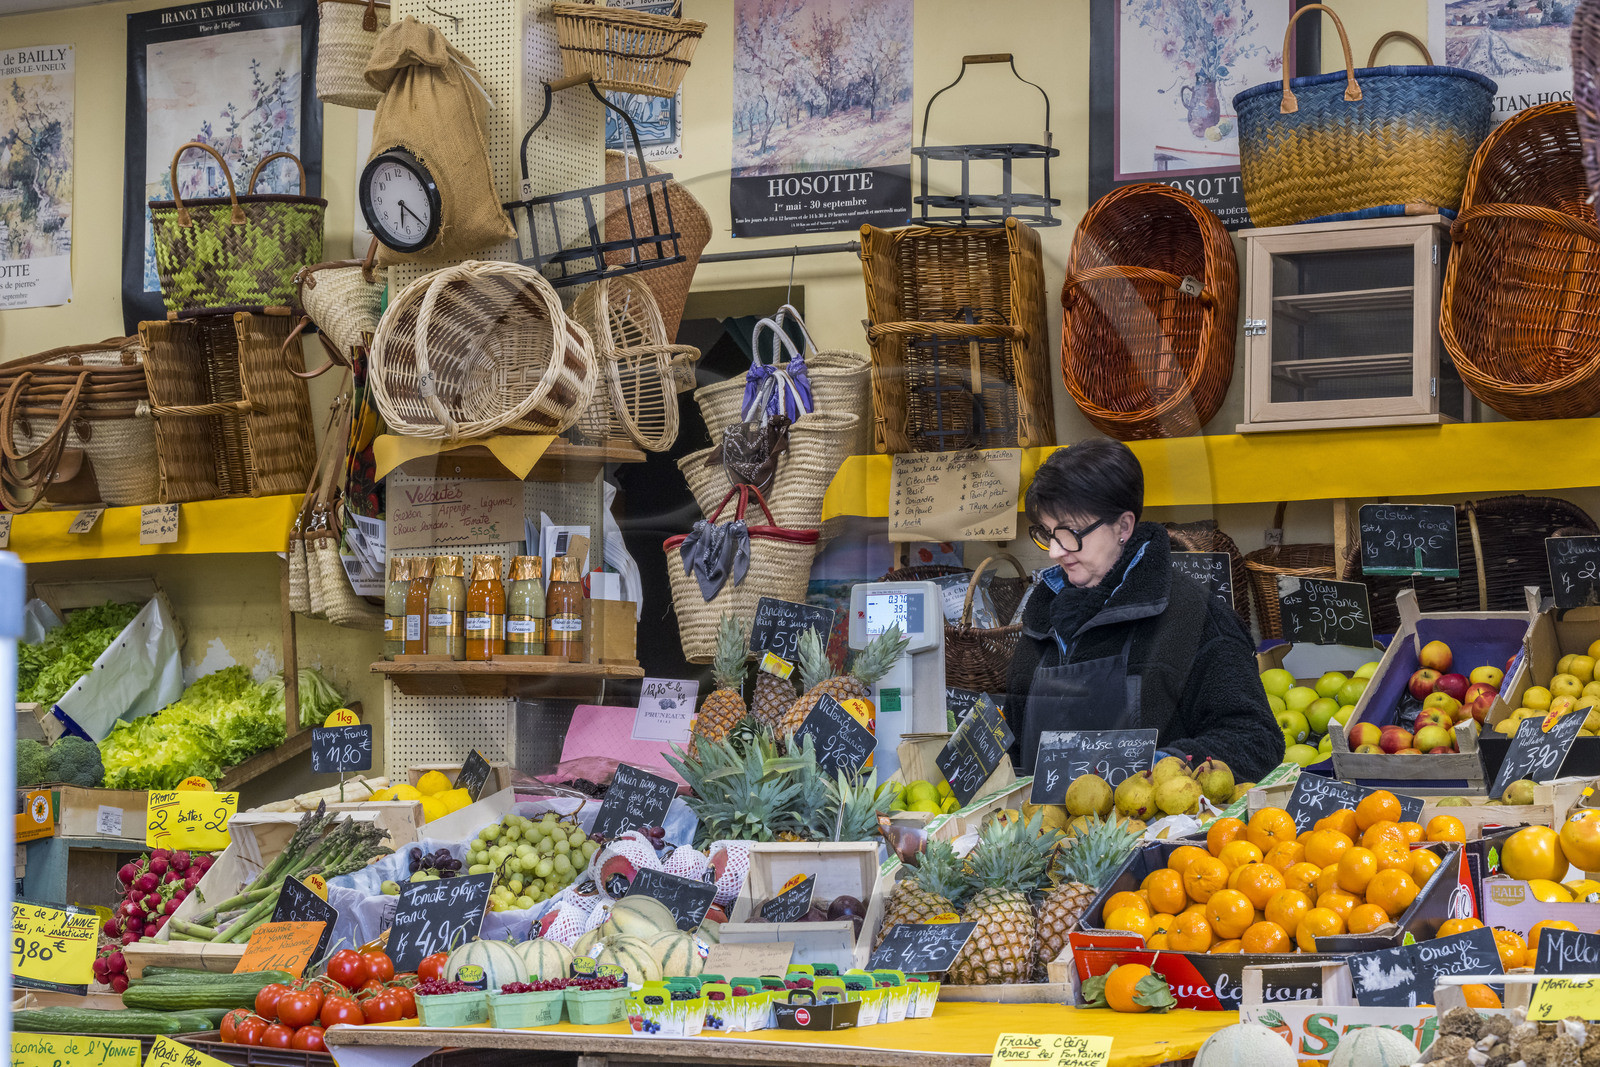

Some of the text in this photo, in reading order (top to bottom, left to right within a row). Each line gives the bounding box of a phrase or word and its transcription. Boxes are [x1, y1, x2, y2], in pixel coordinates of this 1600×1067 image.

[161, 0, 283, 24] IRANCY EN BOURGOGNE
[200, 22, 213, 32] Place
[4, 48, 66, 66] de BAILLY
[384, 172, 392, 181] 11
[394, 168, 402, 178] 12
[407, 172, 412, 180] 1
[379, 182, 386, 191] 10
[418, 182, 423, 192] 2
[768, 172, 873, 198] HOSOTTE
[1156, 176, 1241, 197] OSOTT
[378, 196, 383, 206] 9
[424, 198, 429, 207] 3
[786, 202, 802, 211] mai
[810, 200, 820, 209] 30
[823, 197, 867, 210] septembre
[383, 211, 389, 221] 8
[423, 212, 428, 220] 4
[751, 216, 763, 224] jours
[834, 210, 847, 218] heures
[394, 222, 399, 231] 7
[406, 226, 411, 235] 6
[897, 468, 911, 476] qui
[912, 466, 927, 475] sont
[946, 464, 967, 474] frigo
[404, 483, 464, 504] Veloutés
[393, 508, 422, 522] Cresson
[438, 504, 471, 519] Asperge
[460, 514, 492, 527] Tomate
[760, 604, 798, 619] Ananas
[336, 711, 353, 725] 1kg
[644, 712, 687, 720] PRUNEAUX
[187, 780, 206, 788] Pièce
[149, 810, 168, 831] 2
[204, 808, 228, 833] 2
[221, 794, 235, 805] €
[404, 884, 448, 907] Tomate
[1492, 888, 1524, 898] HALLS
[34, 908, 47, 920] de
[396, 908, 428, 927] France
[48, 924, 94, 940] insecticides
[1539, 1003, 1553, 1017] Kg
[64, 1040, 81, 1054] de
[1000, 1036, 1042, 1048] Fraise
[152, 1040, 180, 1063] Radis
[998, 1047, 1107, 1059] Pernes les Fontaines
